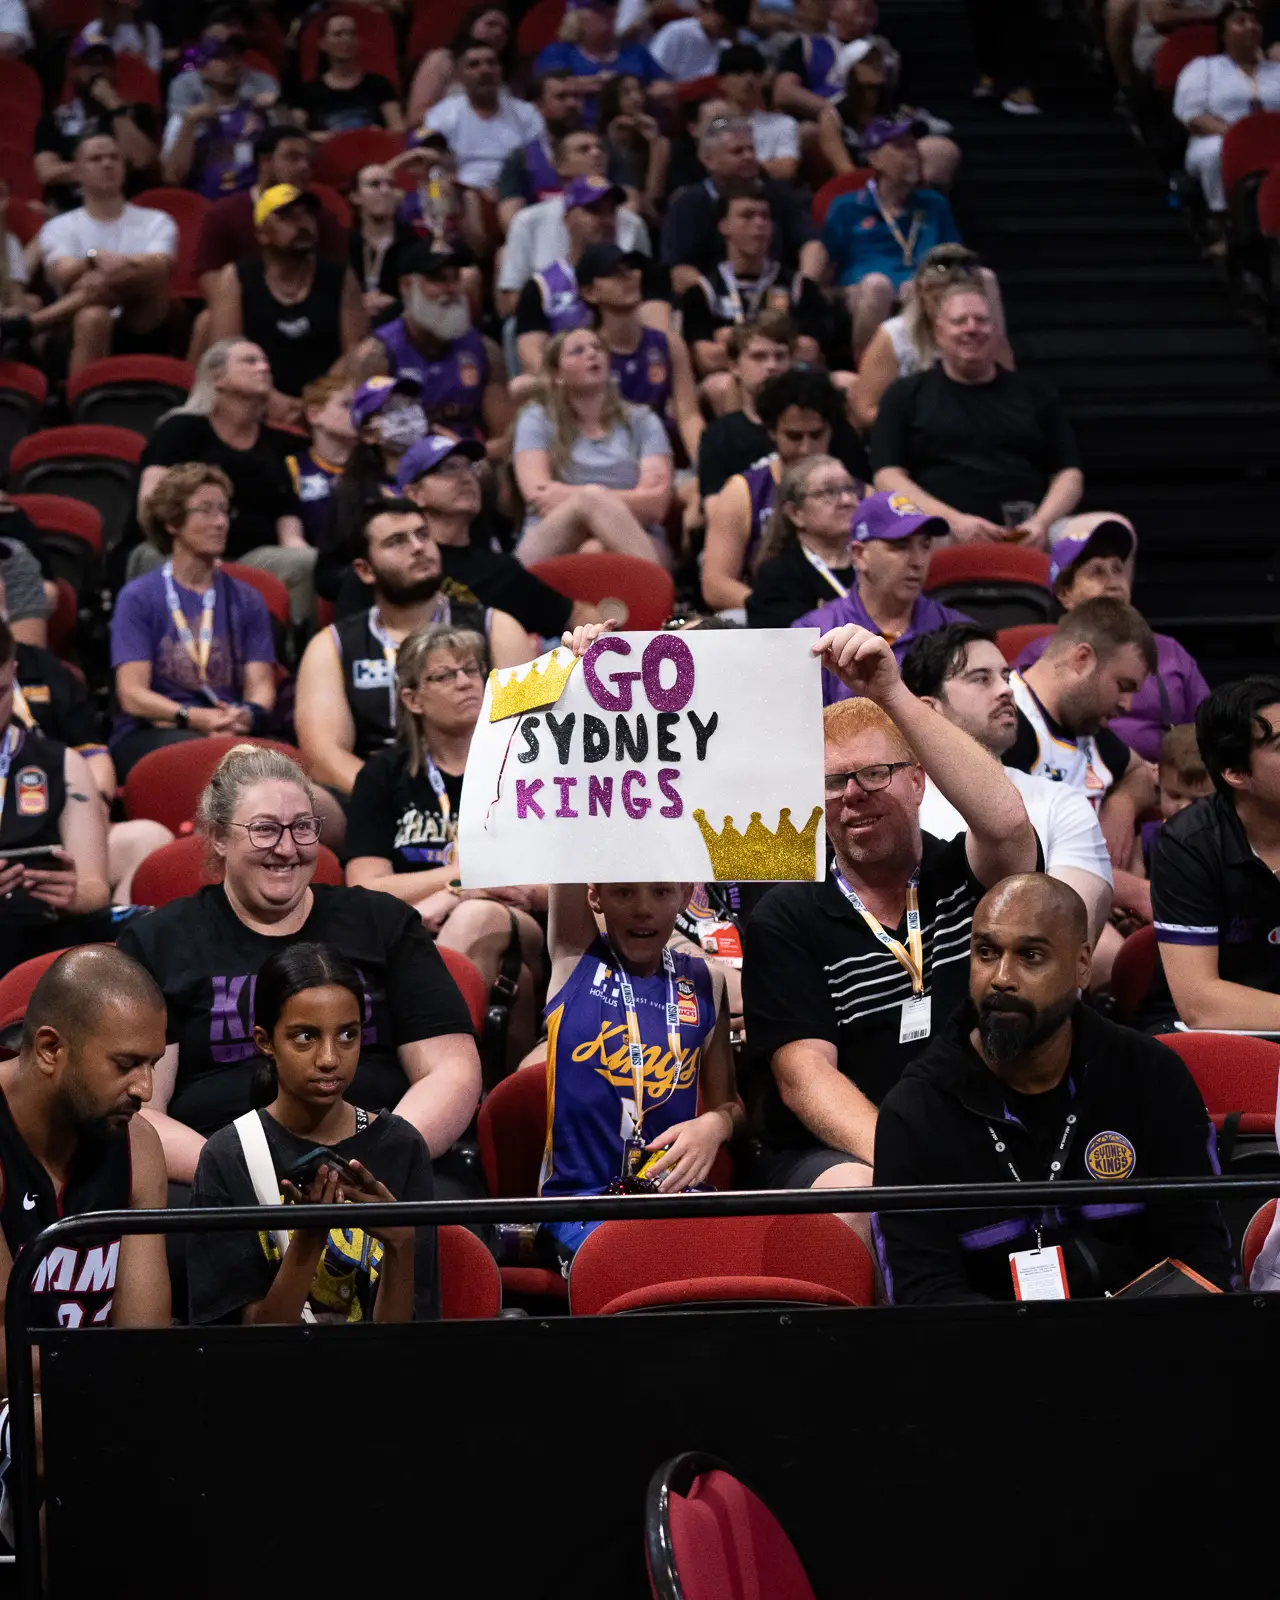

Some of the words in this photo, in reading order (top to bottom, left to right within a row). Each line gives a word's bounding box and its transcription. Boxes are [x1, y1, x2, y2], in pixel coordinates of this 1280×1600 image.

[582, 634, 695, 713] GO
[517, 711, 719, 765] SYDNEY
[515, 768, 685, 820] KINGS
[908, 911, 919, 930] KINGS
[622, 984, 634, 1006] KINGS
[667, 1004, 678, 1024] KINGS
[571, 1020, 700, 1098] Kings
[631, 1044, 642, 1066] KINGS
[1094, 1145, 1127, 1159] SYDNEY
[1095, 1157, 1128, 1173] KINGS
